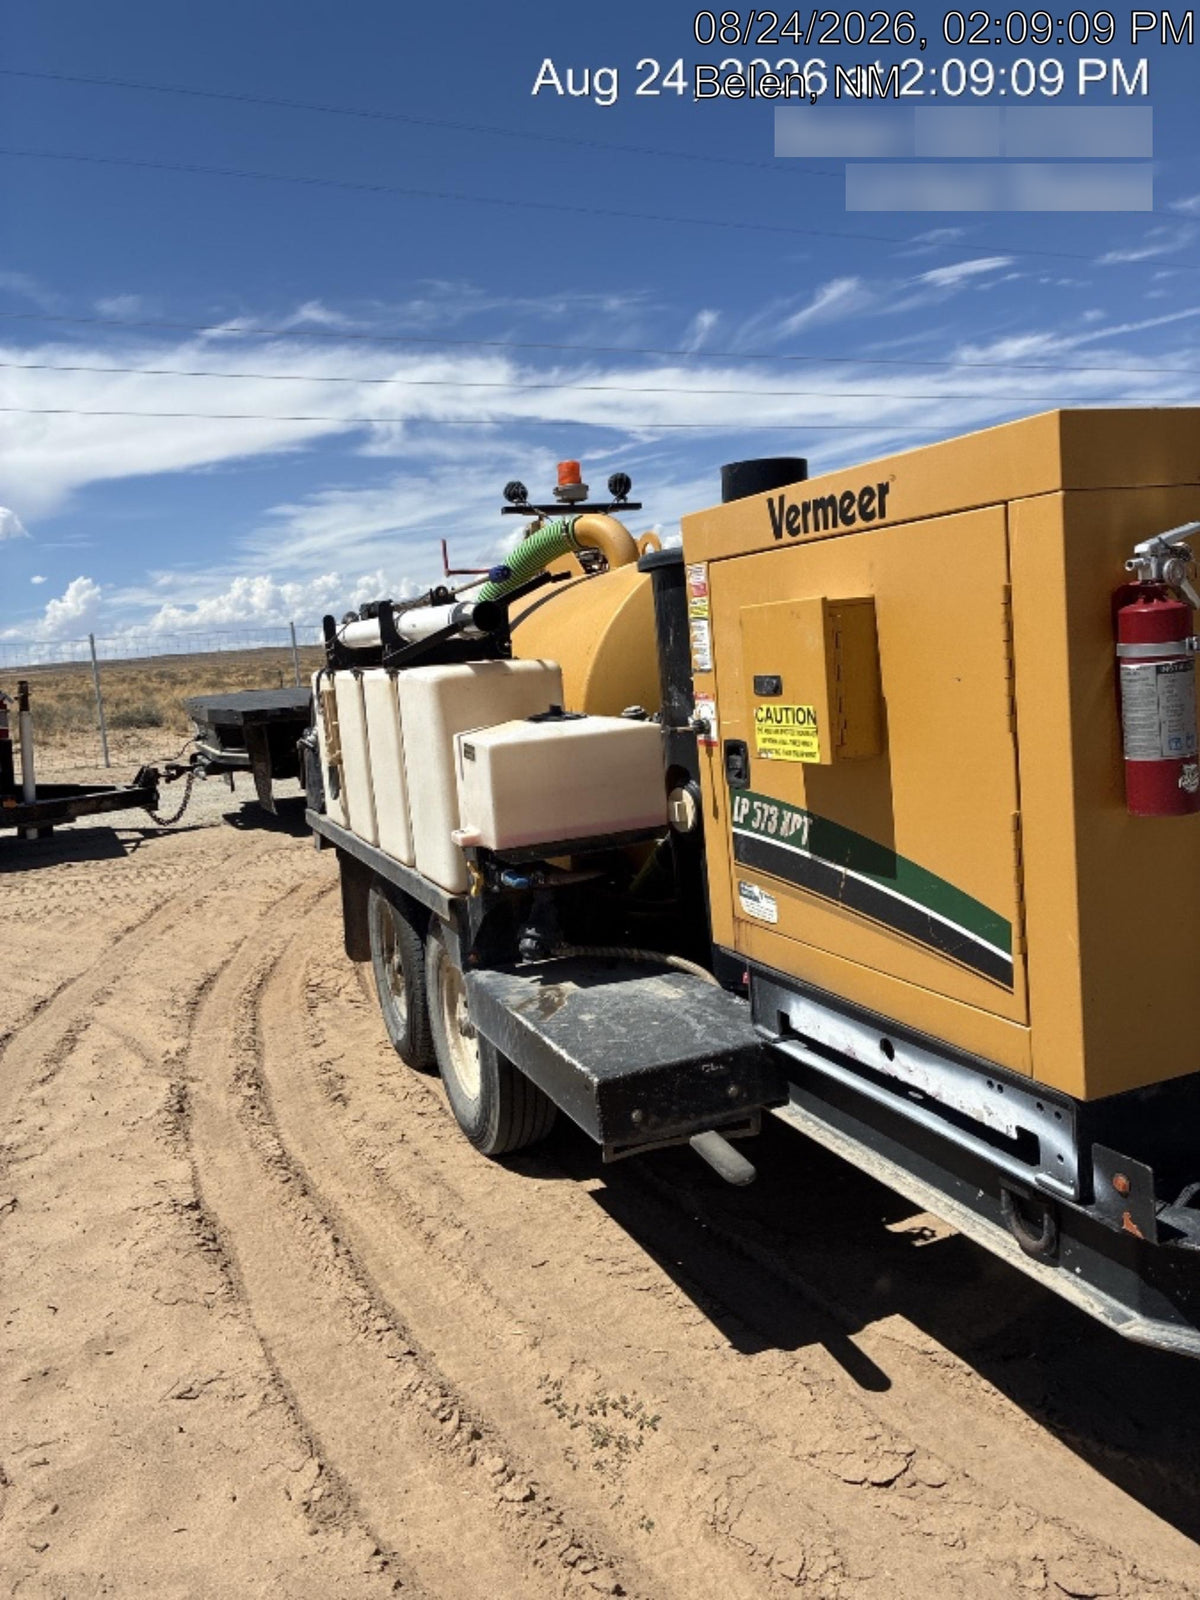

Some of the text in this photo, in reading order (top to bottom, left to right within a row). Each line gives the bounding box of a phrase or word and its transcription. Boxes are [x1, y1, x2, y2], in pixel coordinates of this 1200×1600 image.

[767, 480, 890, 540] Vermeer
[755, 706, 817, 726] CAUTION
[751, 801, 779, 835] 573
